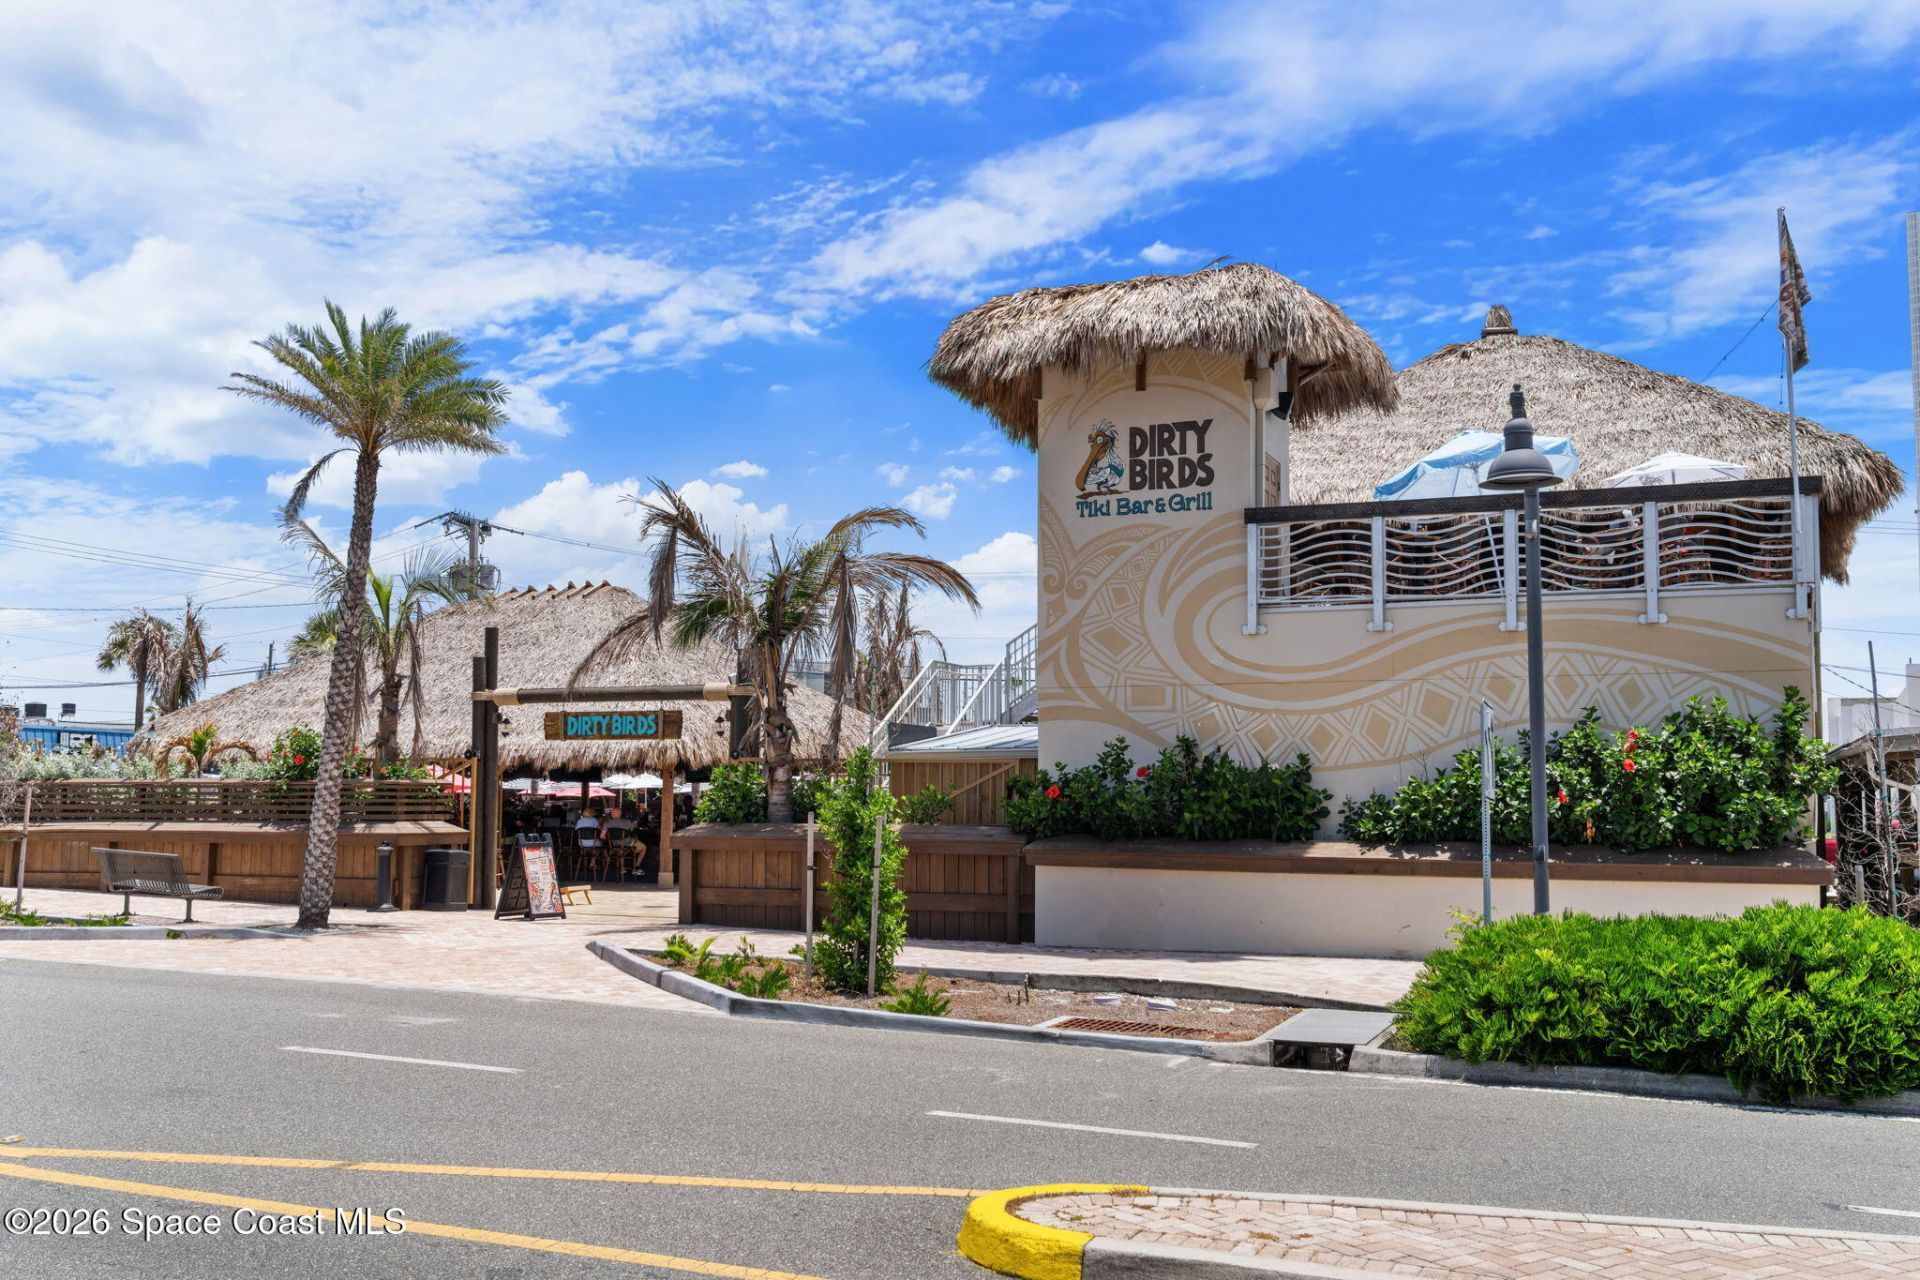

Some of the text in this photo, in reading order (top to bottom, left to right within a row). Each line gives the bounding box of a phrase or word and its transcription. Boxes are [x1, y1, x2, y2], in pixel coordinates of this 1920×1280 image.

[1129, 419, 1214, 458] DIRTY
[1129, 453, 1215, 491] BIRDS
[1076, 500, 1110, 518] Tiki
[566, 714, 657, 736] DIRTY BIRDS
